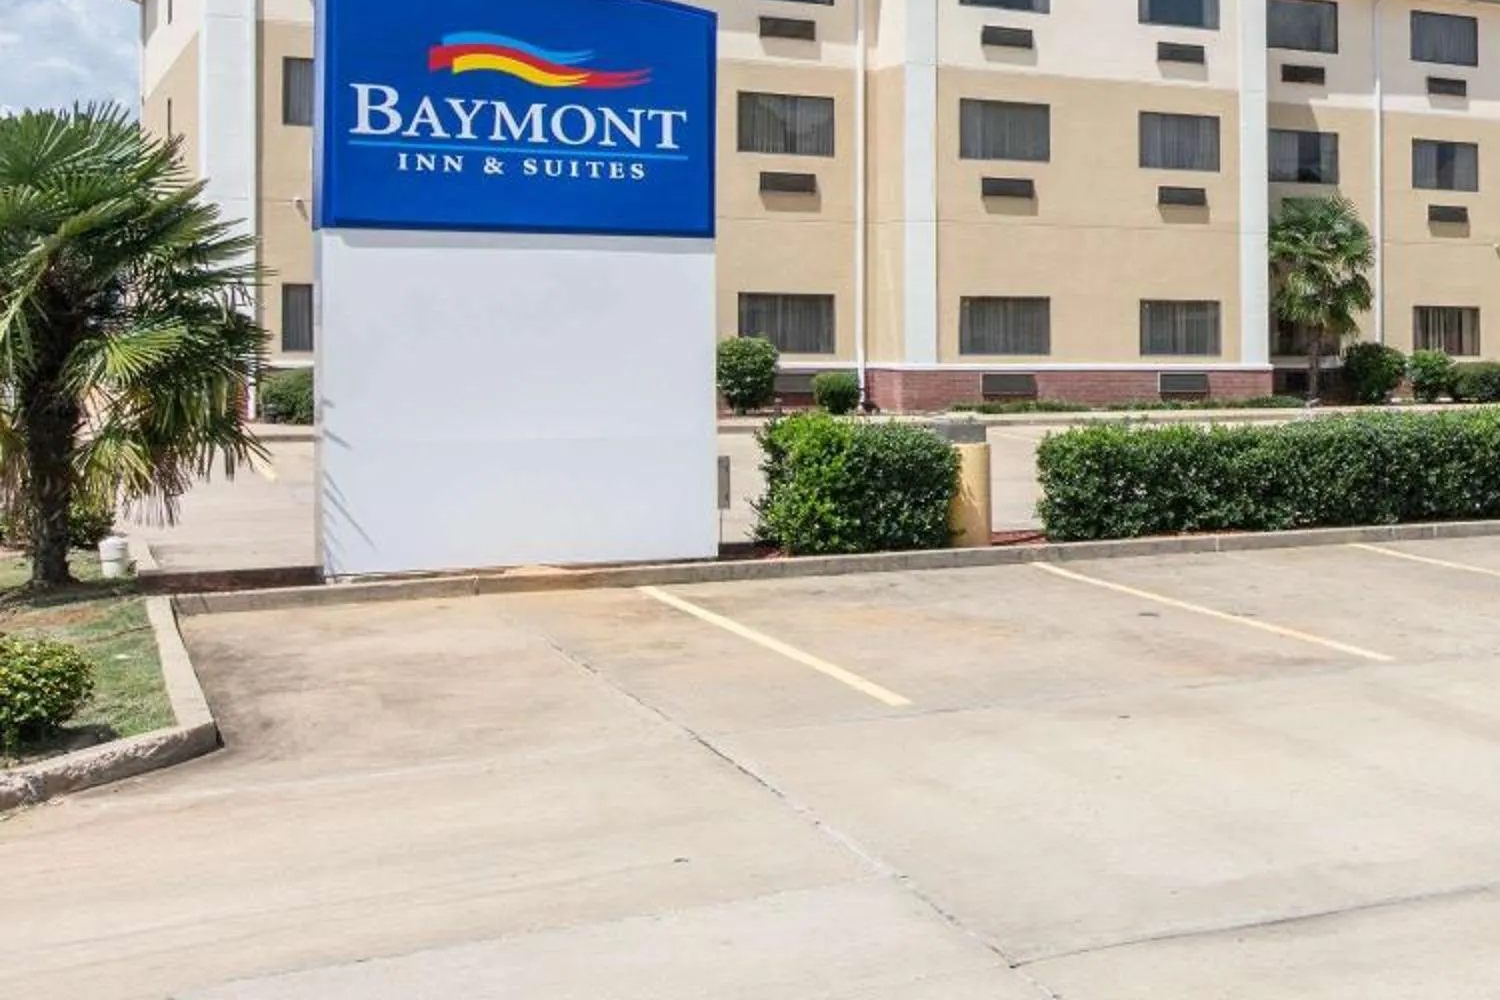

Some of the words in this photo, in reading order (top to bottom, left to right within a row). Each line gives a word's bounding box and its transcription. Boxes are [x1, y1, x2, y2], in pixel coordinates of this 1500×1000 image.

[349, 83, 688, 150] BAYMONT
[398, 152, 464, 172] INN
[483, 156, 504, 176] &
[523, 159, 646, 180] SUITES
